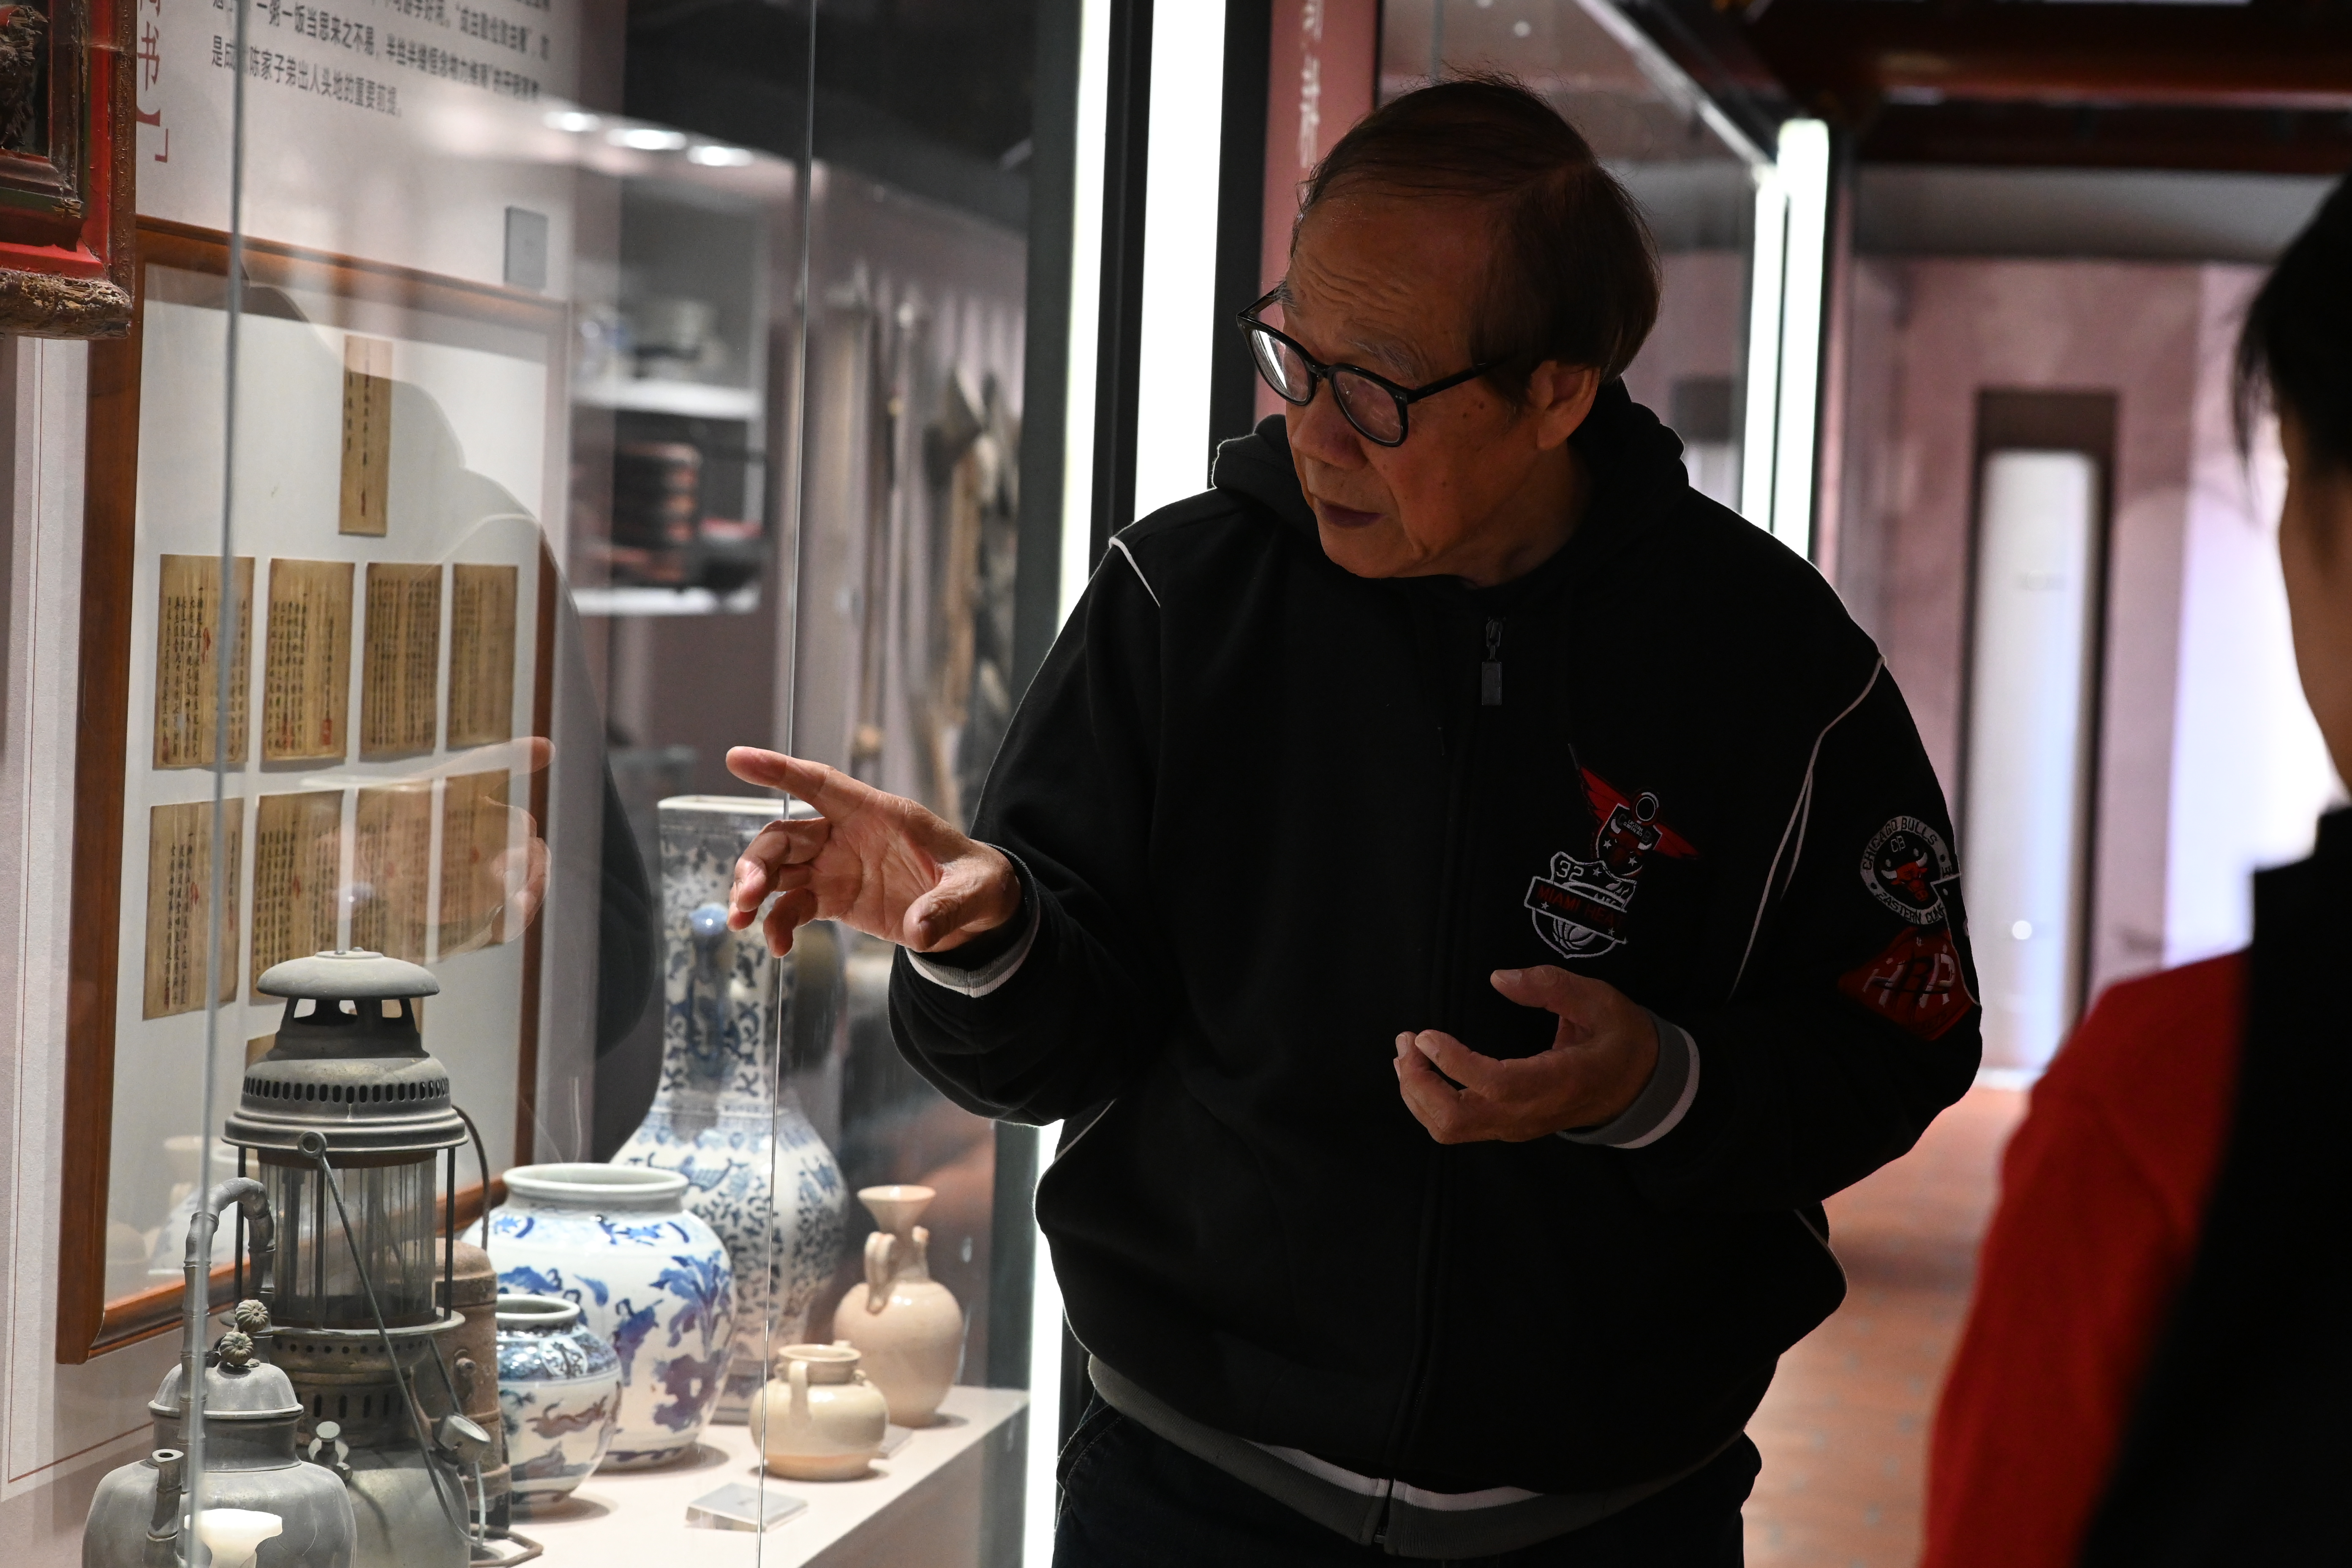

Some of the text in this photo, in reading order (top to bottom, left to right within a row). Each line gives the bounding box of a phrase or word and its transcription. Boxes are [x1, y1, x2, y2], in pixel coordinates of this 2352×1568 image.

[1863, 818, 1938, 870] CHICAGO BULLS
[1556, 860, 1584, 883] 32
[1536, 884, 1582, 913] MIAMI
[1876, 891, 1922, 924] EASTERN
